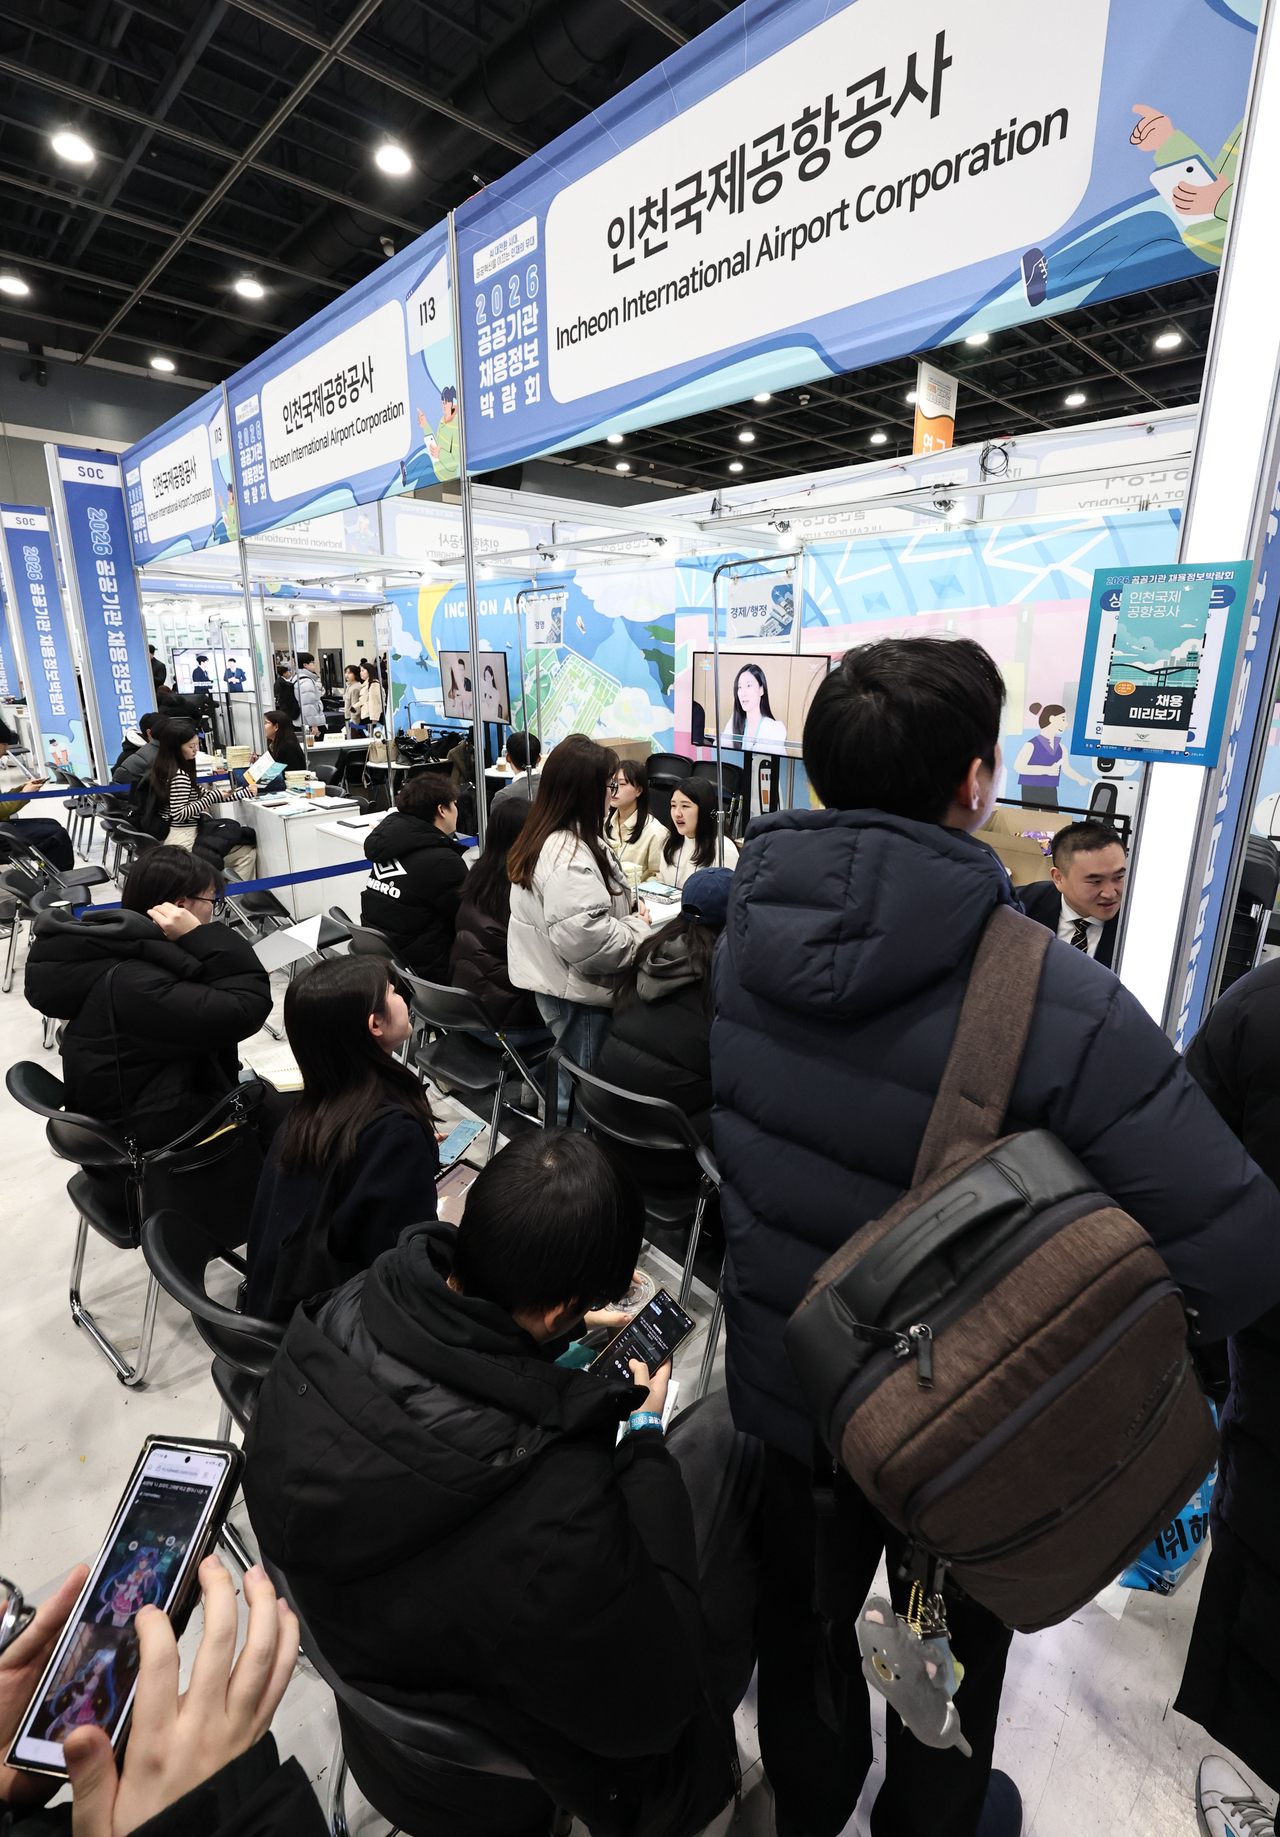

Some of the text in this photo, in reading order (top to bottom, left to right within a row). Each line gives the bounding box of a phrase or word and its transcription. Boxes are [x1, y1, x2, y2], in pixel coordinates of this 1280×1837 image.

[607, 29, 953, 274] 인천국제공항공사
[555, 106, 1069, 350] Incheon International Airport Corporation
[475, 264, 540, 326] 2026
[477, 301, 539, 357] 공공기관
[479, 338, 540, 389] 채용정보
[282, 355, 374, 435] 인천국제공항공사
[269, 401, 405, 472] Incheon International Airport Corporation
[77, 466, 105, 480] SOC
[239, 442, 263, 469] 공공기관
[152, 455, 197, 499] 인천국제공항공사
[15, 516, 36, 527] SOC
[87, 507, 113, 555] 2026
[95, 559, 123, 627] 공공기관
[1106, 570, 1235, 586] 2026 공공기관 채용정보박람회
[444, 599, 497, 618] INCEON
[730, 604, 768, 619] 경제/행정
[1127, 605, 1181, 619] 공항공사
[1129, 590, 1182, 604] 인천국제
[23, 545, 66, 716] 2026 공공기관 채용정보박람회
[1129, 707, 1182, 722] 미리보기
[1155, 694, 1183, 708] 채용
[366, 876, 401, 899] MBRO
